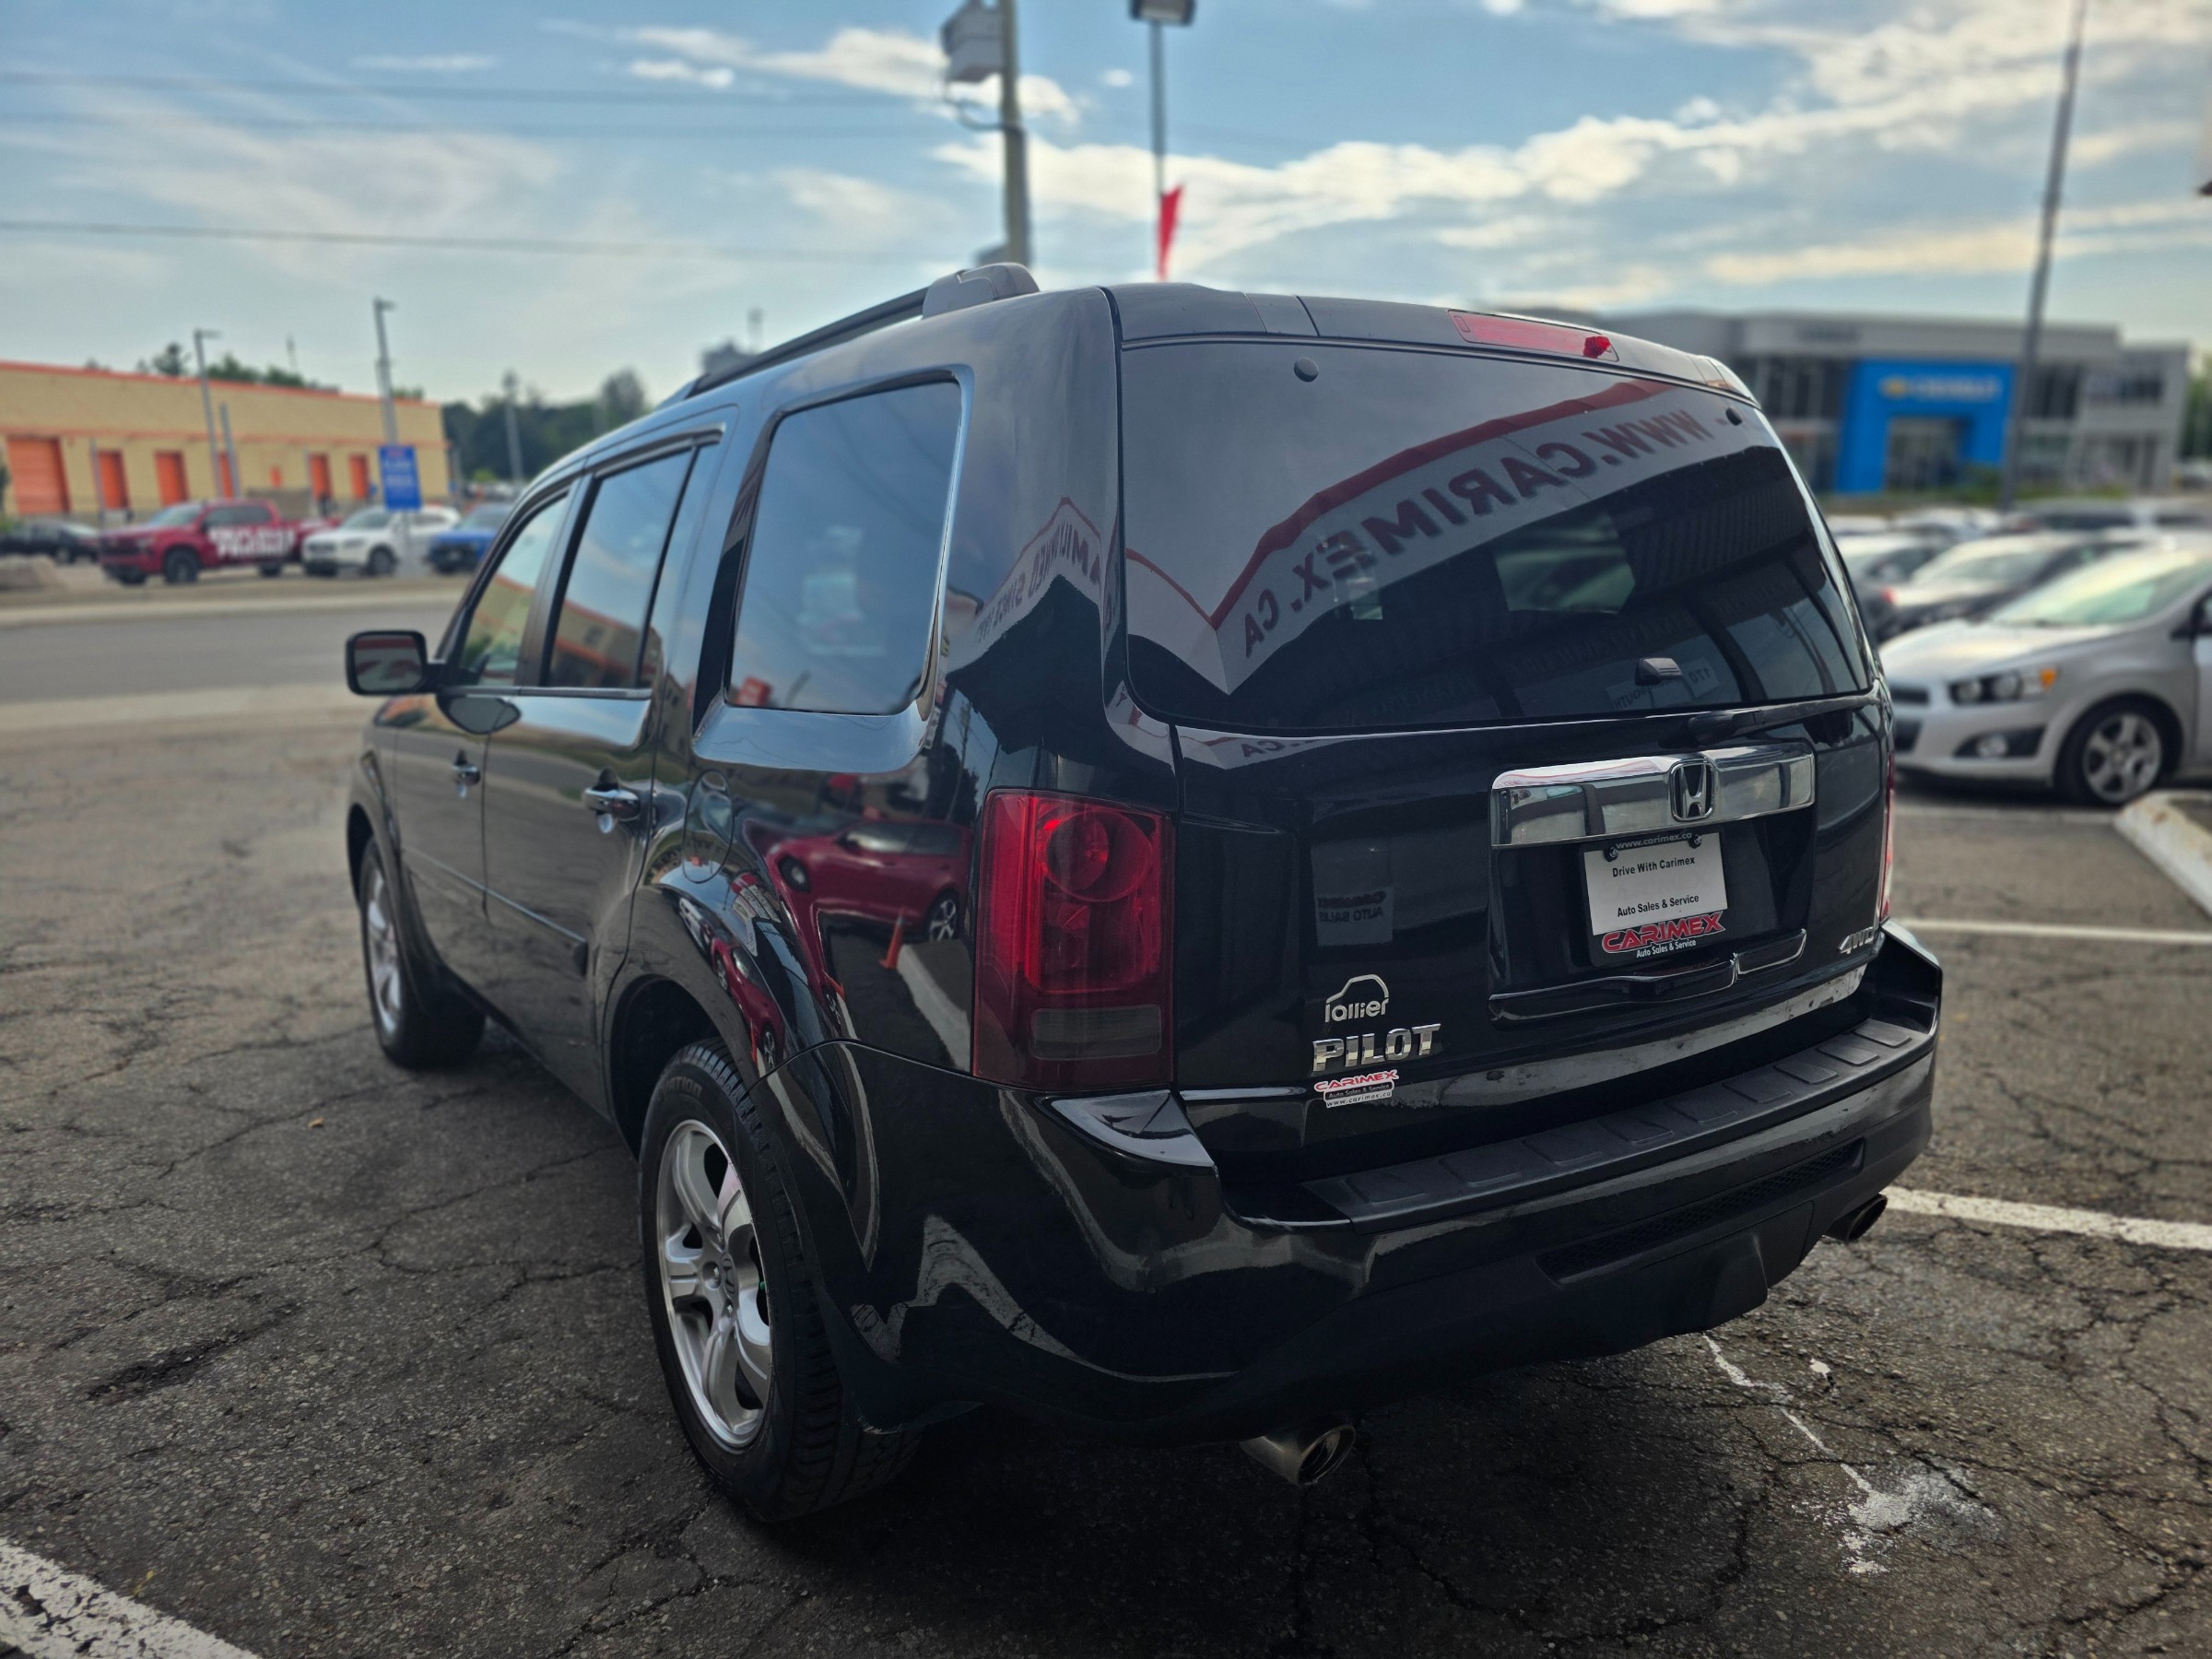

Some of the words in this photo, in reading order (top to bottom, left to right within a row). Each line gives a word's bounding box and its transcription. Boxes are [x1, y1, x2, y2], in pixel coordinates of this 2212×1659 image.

[1616, 831, 1693, 850] www.carimex.ca
[1612, 866, 1636, 877] Drive
[1637, 861, 1657, 873] With
[1659, 857, 1695, 869] Carimex
[1618, 905, 1636, 917] Auto
[1637, 900, 1660, 913] Sales
[1662, 899, 1668, 908] &
[1669, 895, 1700, 908] Service
[1602, 911, 1725, 953] CARIMEX
[1636, 947, 1651, 959] Auto
[1652, 944, 1668, 956] Sales
[1675, 939, 1697, 950] Service
[1312, 1023, 1441, 1072] PILOT
[1315, 1070, 1398, 1090] CARIMEX
[1325, 1091, 1392, 1108] www.carimex.ca
[1328, 1090, 1344, 1100] Auto
[1345, 1088, 1361, 1097] Sales
[1369, 1083, 1391, 1092] Service
